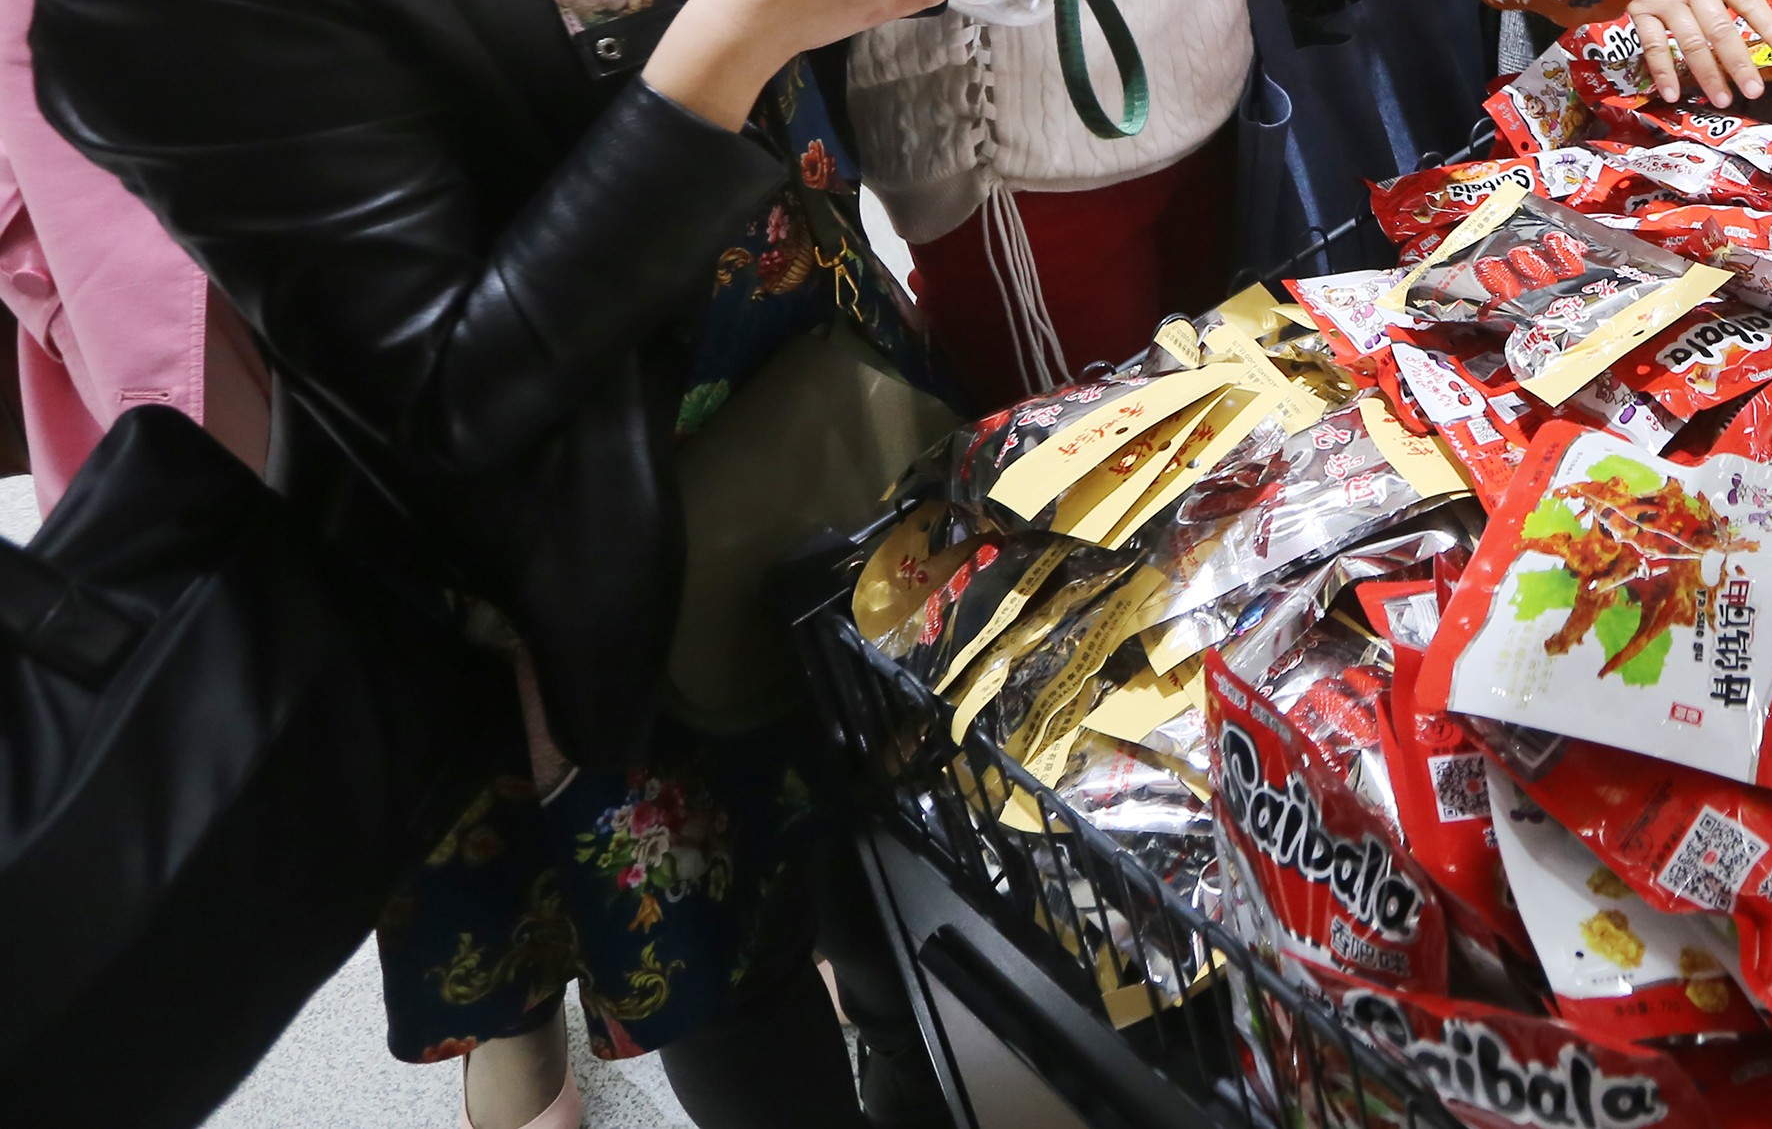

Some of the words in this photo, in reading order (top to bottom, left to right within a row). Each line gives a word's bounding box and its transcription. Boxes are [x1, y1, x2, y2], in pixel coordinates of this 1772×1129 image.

[1696, 590, 1707, 606] ya
[1710, 578, 1757, 707] 鸭锁骨
[1221, 727, 1425, 939] Saibala
[1352, 995, 1660, 1129] Saibala
